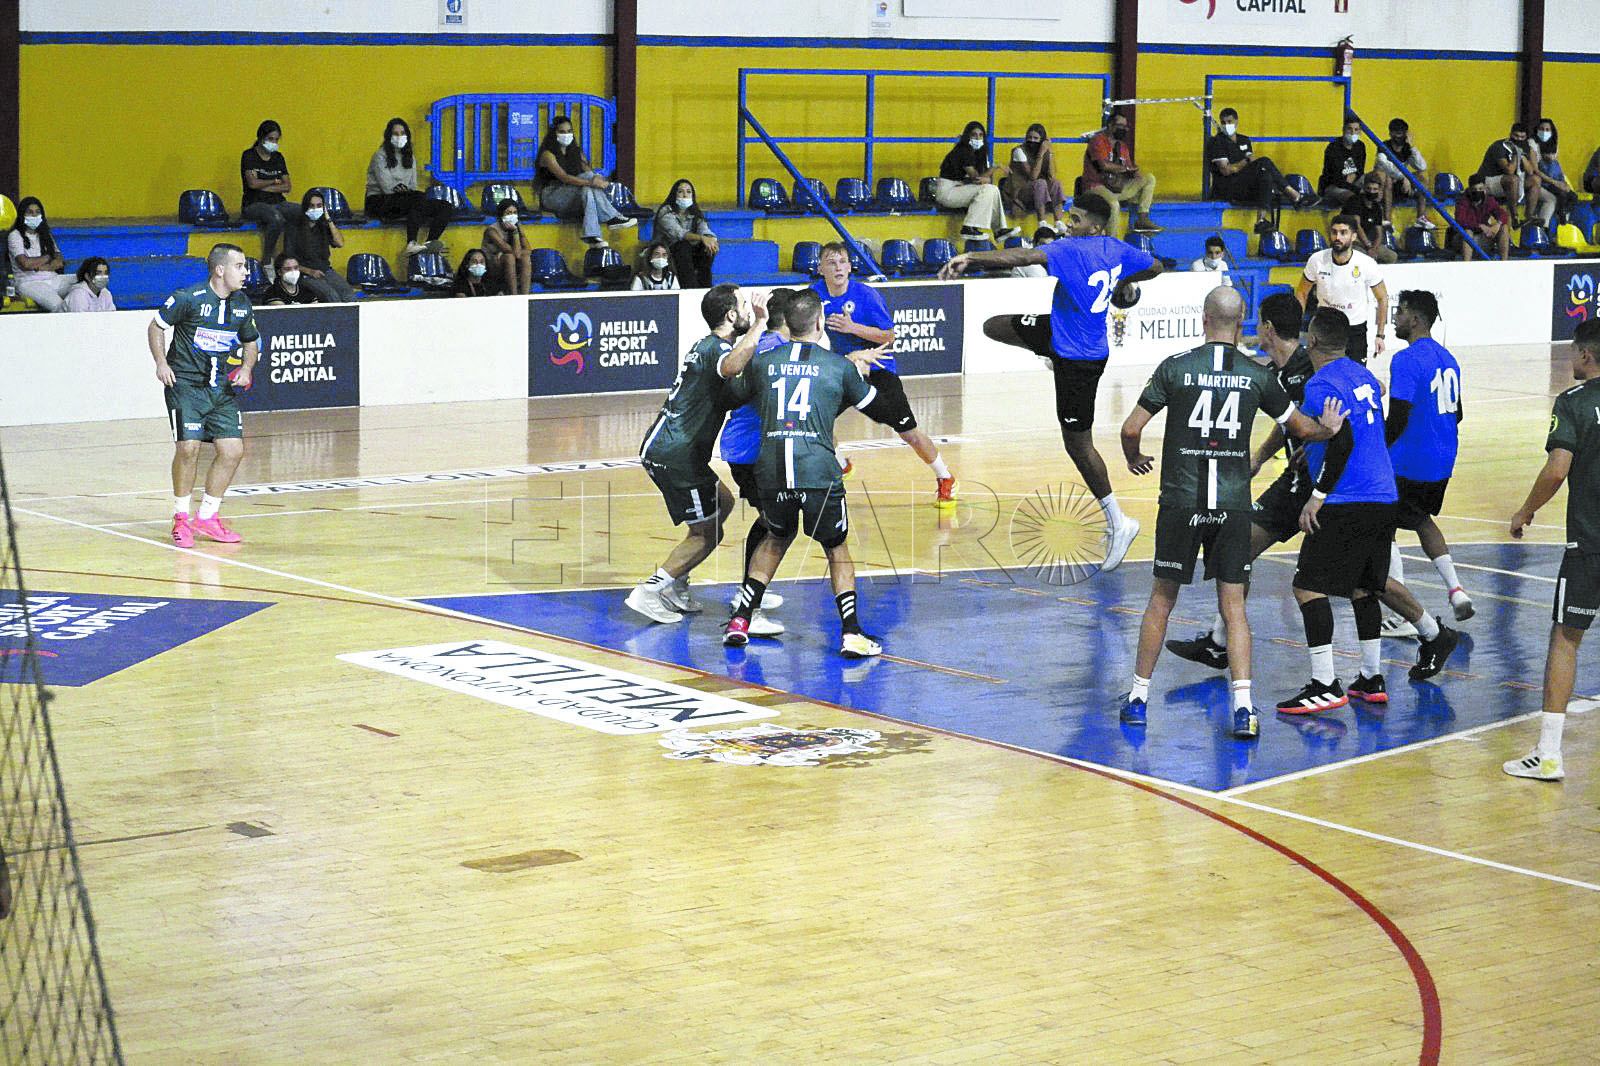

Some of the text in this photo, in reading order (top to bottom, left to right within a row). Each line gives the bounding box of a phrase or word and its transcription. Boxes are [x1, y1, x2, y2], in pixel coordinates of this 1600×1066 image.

[200, 303, 213, 316] 10
[893, 308, 946, 323] MELILLA
[1138, 304, 1203, 317] CIUDAD AUTÓNO
[599, 320, 658, 335] MELILLA
[893, 323, 936, 338] SPORT
[1140, 318, 1207, 340] MELILL
[270, 333, 336, 350] MELILLA
[599, 336, 648, 352] SPORT
[893, 338, 945, 353] CAPITAL
[270, 350, 323, 367] SPORT
[599, 351, 659, 367] CAPITAL
[270, 366, 336, 384] CAPITAL
[780, 364, 820, 377] VENTAS
[1184, 373, 1252, 390] D. MARTINEZ
[771, 377, 811, 421] 14
[1430, 367, 1460, 415] 10
[1188, 389, 1242, 439] 44
[41, 601, 170, 640] CAPITAL
[434, 643, 745, 724] MELILLA
[538, 697, 659, 730] CIUDAD
